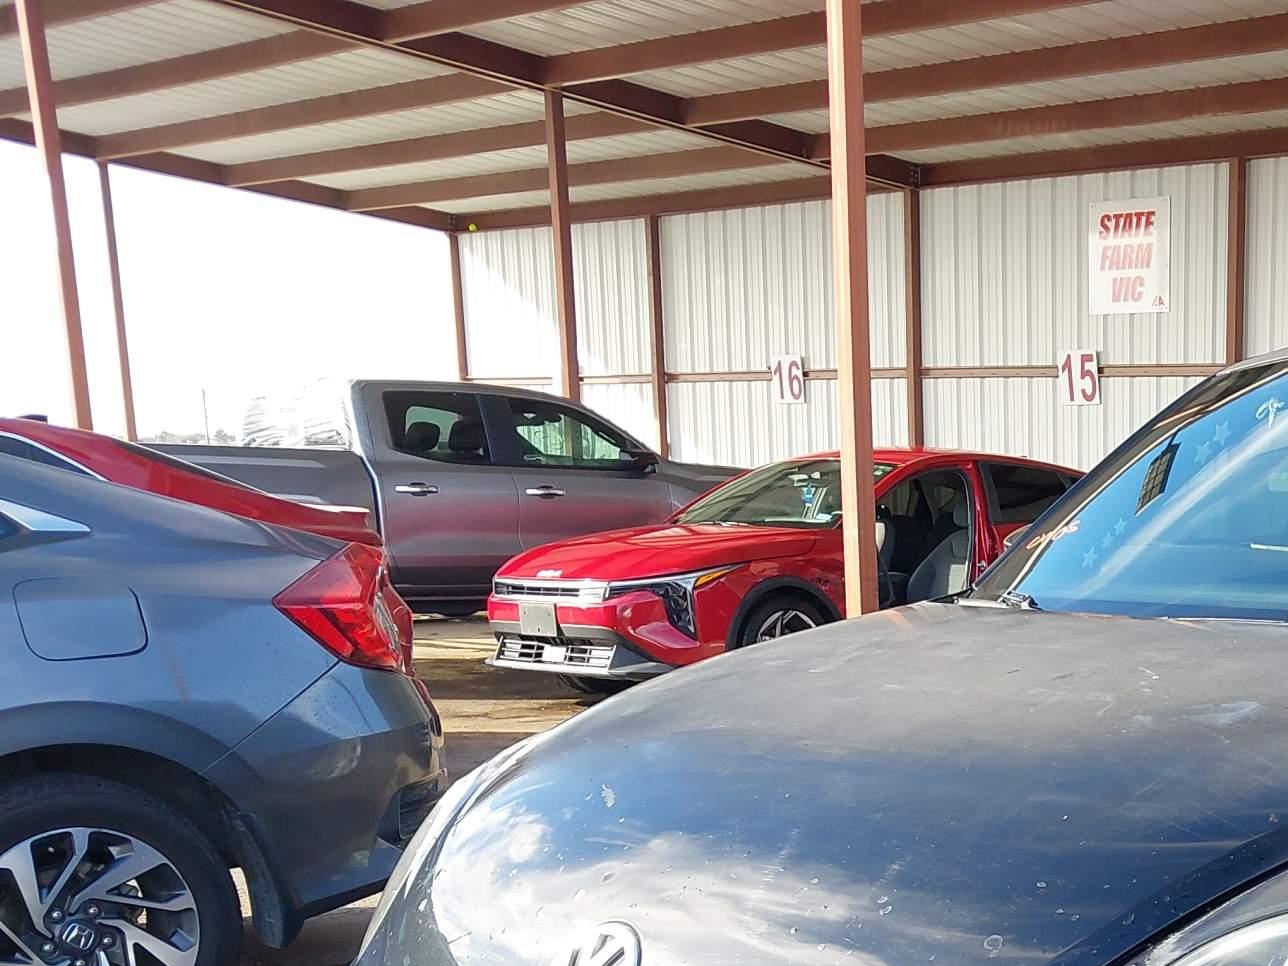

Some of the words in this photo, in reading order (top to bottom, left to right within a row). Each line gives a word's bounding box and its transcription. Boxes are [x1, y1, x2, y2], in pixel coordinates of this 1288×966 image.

[1099, 210, 1156, 241] STATE
[1099, 242, 1154, 271] FARM
[1111, 275, 1146, 303] VIC
[773, 359, 802, 401] 16
[1061, 353, 1097, 402] 15
